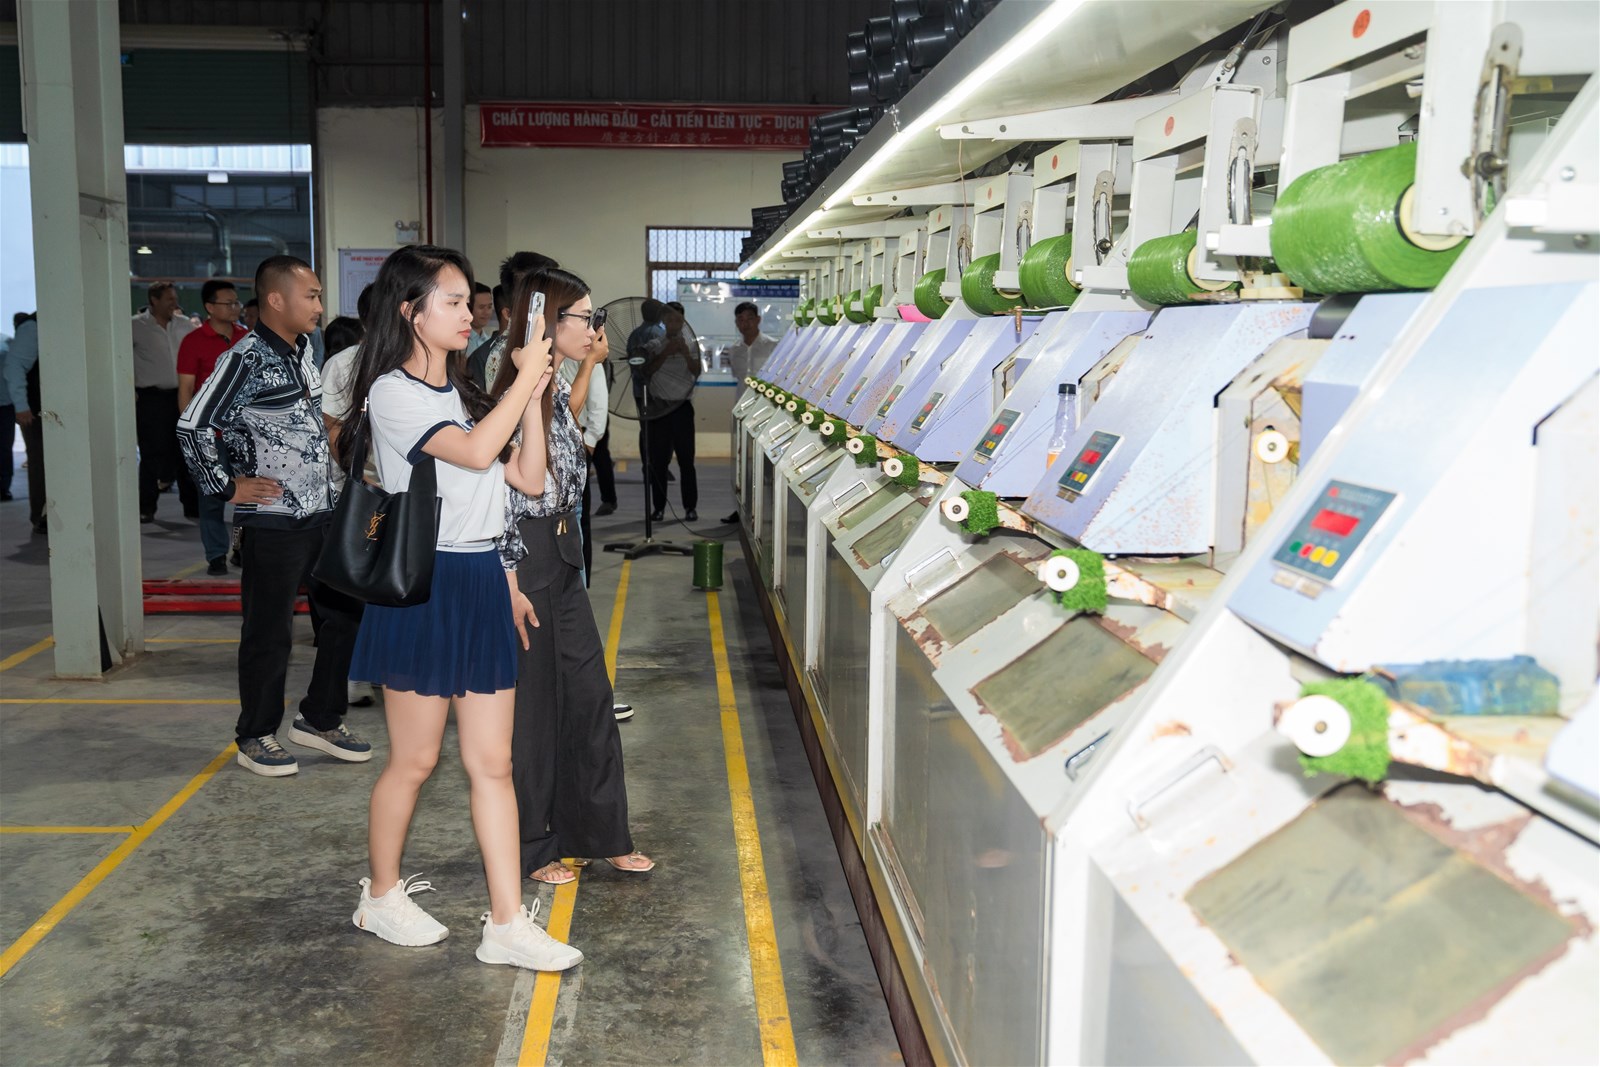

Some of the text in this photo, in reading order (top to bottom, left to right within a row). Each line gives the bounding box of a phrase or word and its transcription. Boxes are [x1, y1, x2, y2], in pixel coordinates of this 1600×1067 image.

[492, 107, 525, 126] CHẤT
[528, 110, 570, 129] LƯỢNG
[574, 110, 609, 127] HÀNG
[612, 109, 638, 128] ĐẦU
[650, 109, 672, 128] CẢI
[675, 110, 704, 128] TIẾN
[707, 112, 735, 129] LIÊN
[738, 114, 762, 131] TỤC
[774, 115, 804, 132] DỊCH
